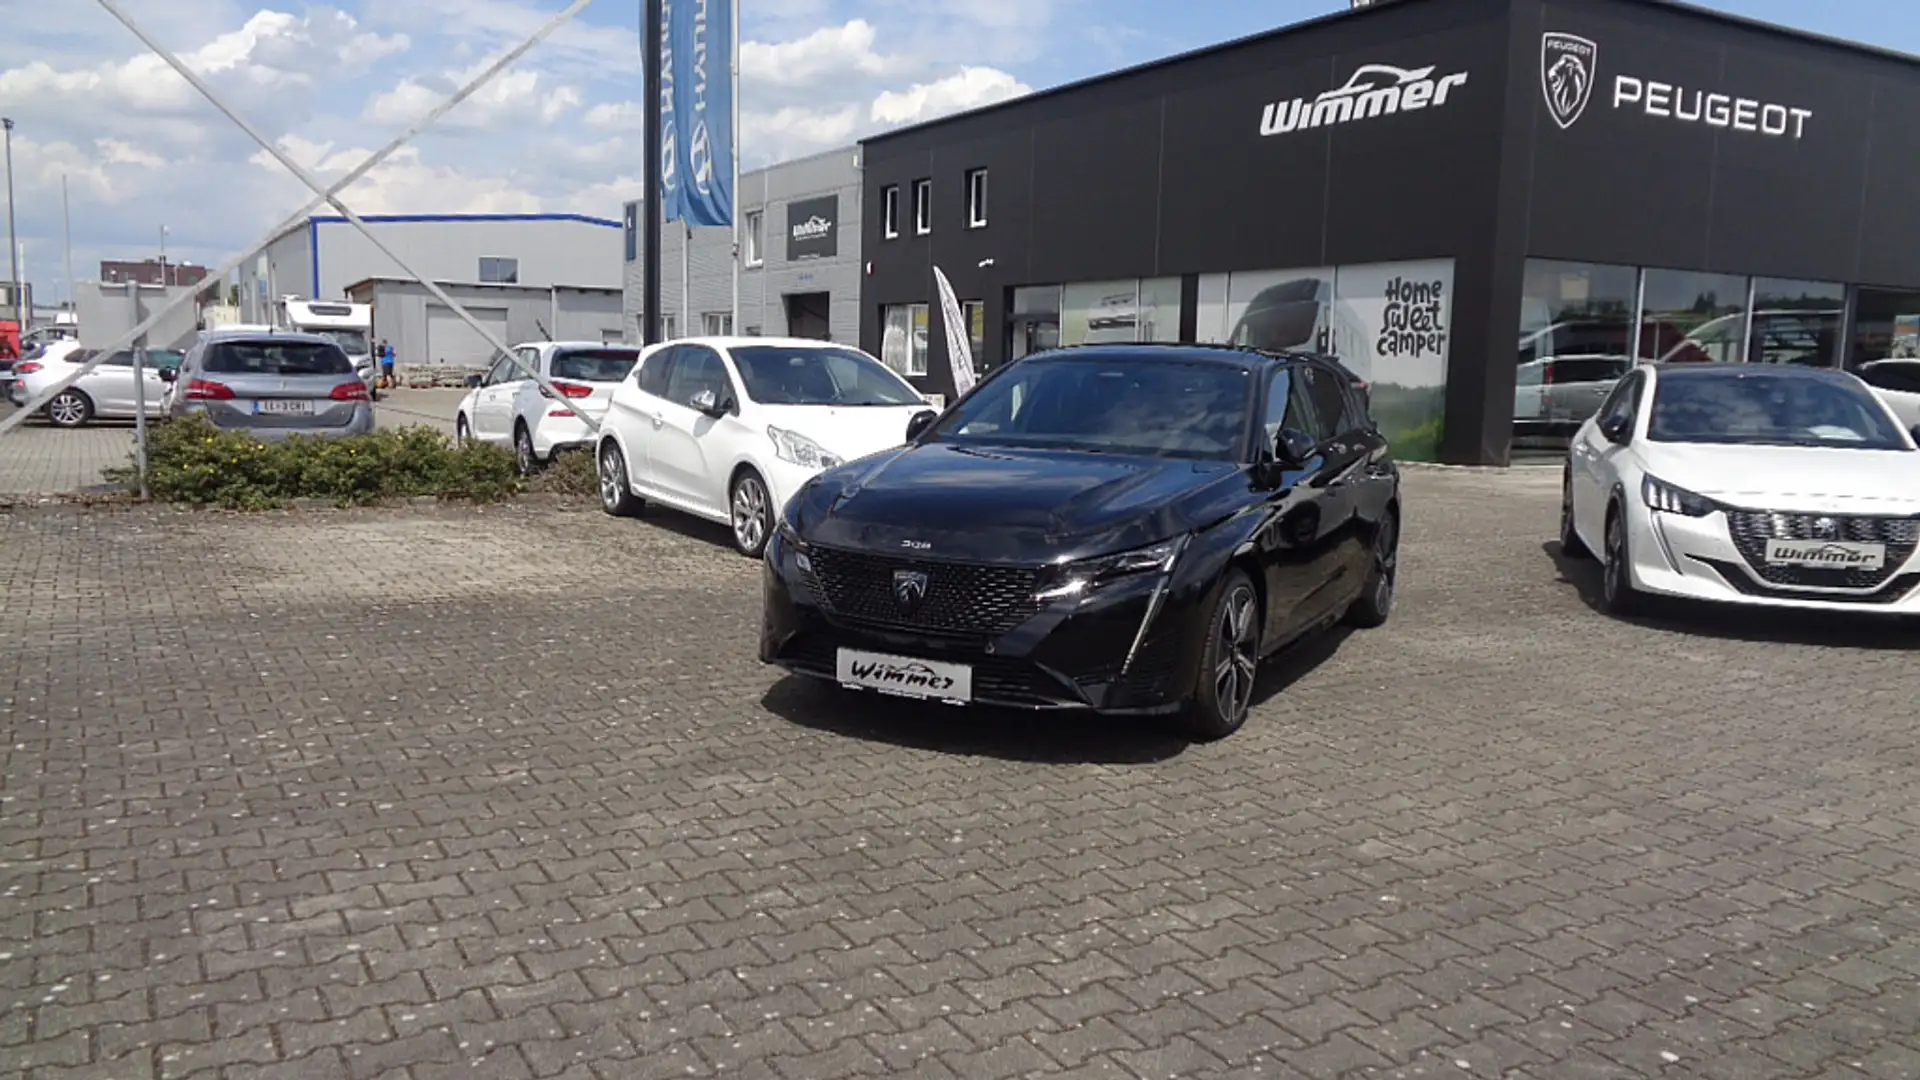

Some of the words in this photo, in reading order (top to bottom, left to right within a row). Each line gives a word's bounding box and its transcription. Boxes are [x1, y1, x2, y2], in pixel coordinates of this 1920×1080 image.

[1546, 40, 1591, 56] PEUGEOT
[1260, 70, 1468, 136] Wimmer
[1613, 75, 1812, 138] PEUGEOT
[1385, 276, 1443, 304] Home
[1773, 546, 1876, 563] Wimmer
[851, 660, 954, 690] Wimmer
